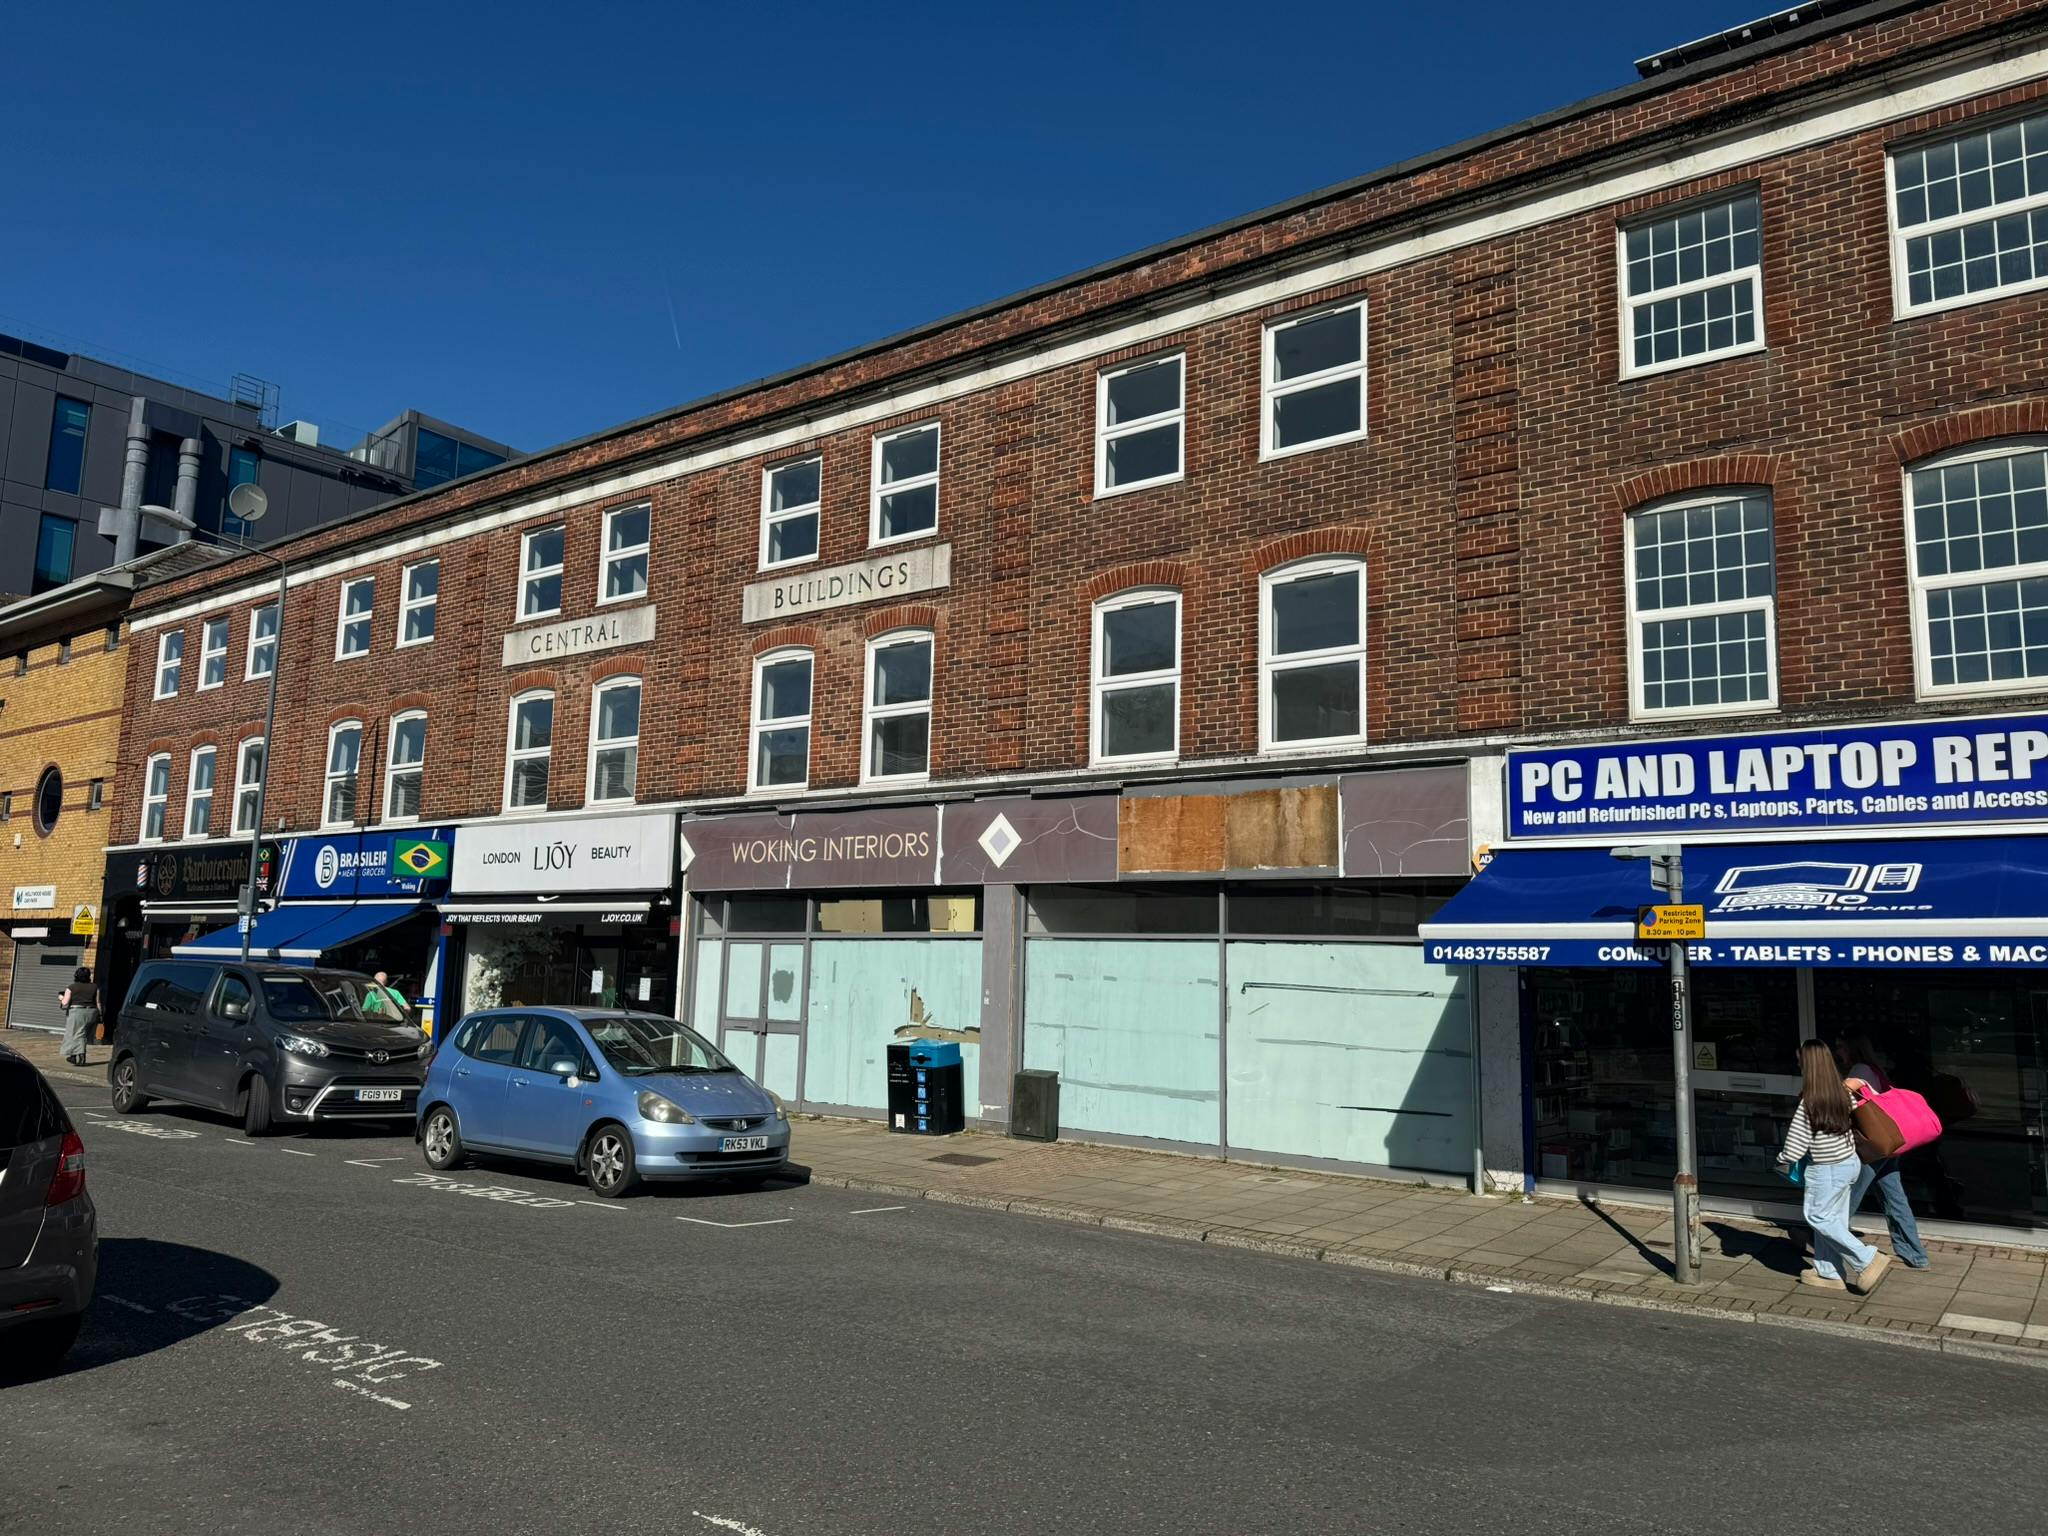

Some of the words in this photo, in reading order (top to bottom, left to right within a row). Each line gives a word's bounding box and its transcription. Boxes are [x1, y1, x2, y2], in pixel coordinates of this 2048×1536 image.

[773, 562, 909, 609] BUILDINGS
[530, 619, 620, 654] CENTRAL
[1521, 759, 1583, 803] PC
[1594, 753, 1695, 800] AND
[1708, 739, 1917, 794] LAPTOP
[1932, 730, 2048, 784] REP
[1523, 809, 1554, 825] New
[1558, 807, 1586, 824] and
[1589, 803, 1686, 823] Refurbished
[1731, 797, 1803, 820] Laptops,
[1806, 797, 1858, 815] Parts,
[1862, 793, 1928, 813] Cables
[1932, 791, 1969, 809] and
[1973, 789, 2048, 808] Access
[483, 851, 521, 865] LONDON
[591, 845, 632, 859] BEAUTY
[732, 838, 817, 864] WOKING
[823, 832, 929, 861] INTERIORS
[361, 867, 385, 876] GROCER
[446, 915, 457, 923] JOY
[458, 915, 471, 923] THAT
[472, 914, 500, 923] REFLECTS
[501, 914, 517, 923] YOUR
[518, 914, 542, 923] BEAUTY
[601, 913, 643, 922] LJOY.CO.UK
[1659, 917, 1684, 925] Parking
[1433, 946, 1550, 960] 01483755587
[1598, 946, 1713, 961] COMPUER
[1730, 946, 1832, 961] TABLETS
[1853, 946, 1954, 962] PHONES
[1962, 945, 1981, 962] &
[1989, 945, 2048, 962] MAC
[1673, 982, 1682, 1030] 11569
[362, 1090, 381, 1099] FG19
[382, 1090, 399, 1099] YVS
[724, 1138, 748, 1150] RK53
[750, 1137, 765, 1149] VKL
[392, 1172, 576, 1209] DISABLED
